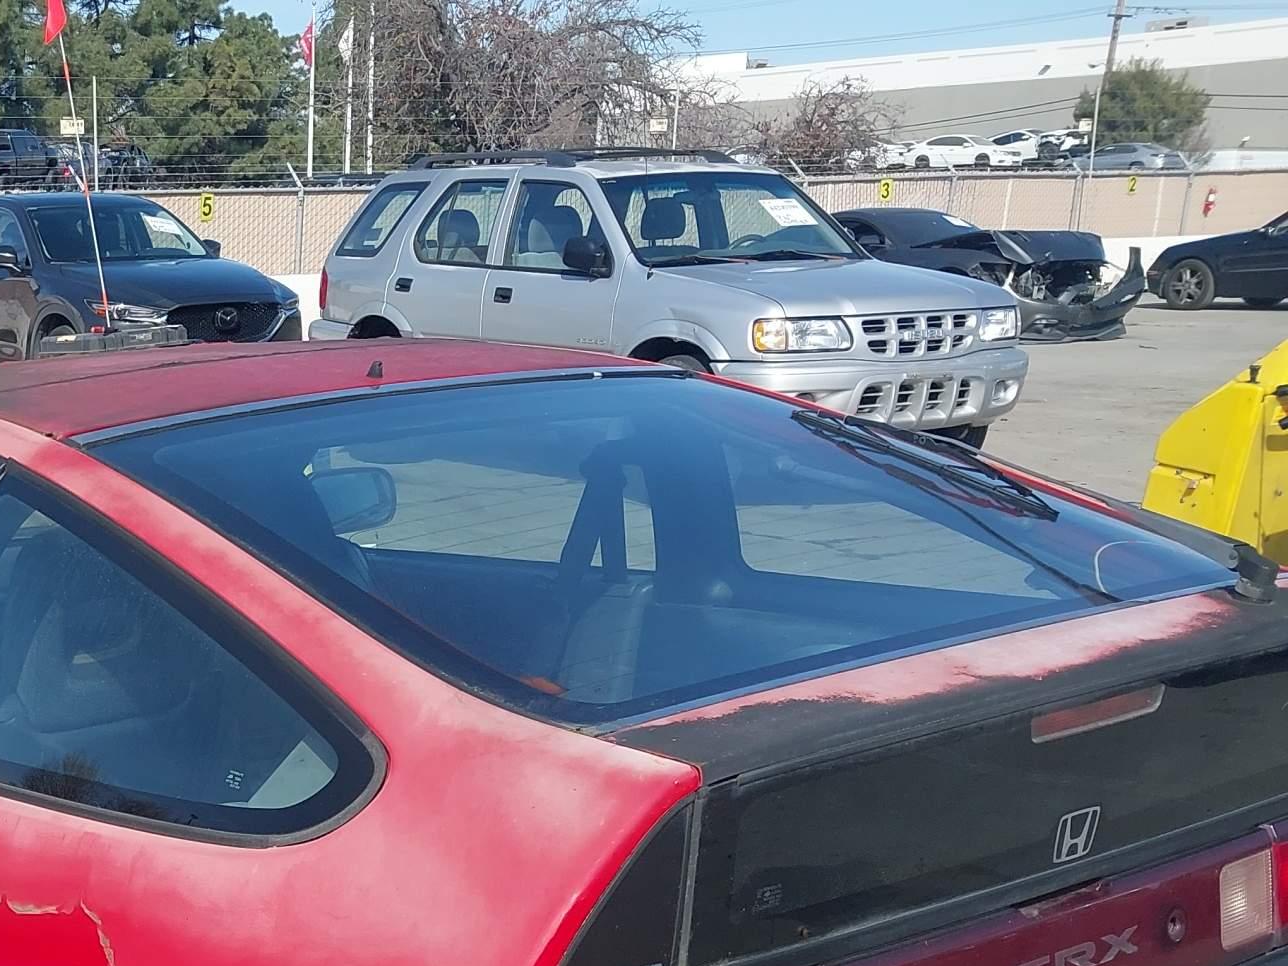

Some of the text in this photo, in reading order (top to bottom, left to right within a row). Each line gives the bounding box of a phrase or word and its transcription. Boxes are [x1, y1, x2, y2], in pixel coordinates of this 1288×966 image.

[881, 182, 890, 199] 3
[1129, 176, 1137, 192] 2
[202, 196, 212, 217] 5
